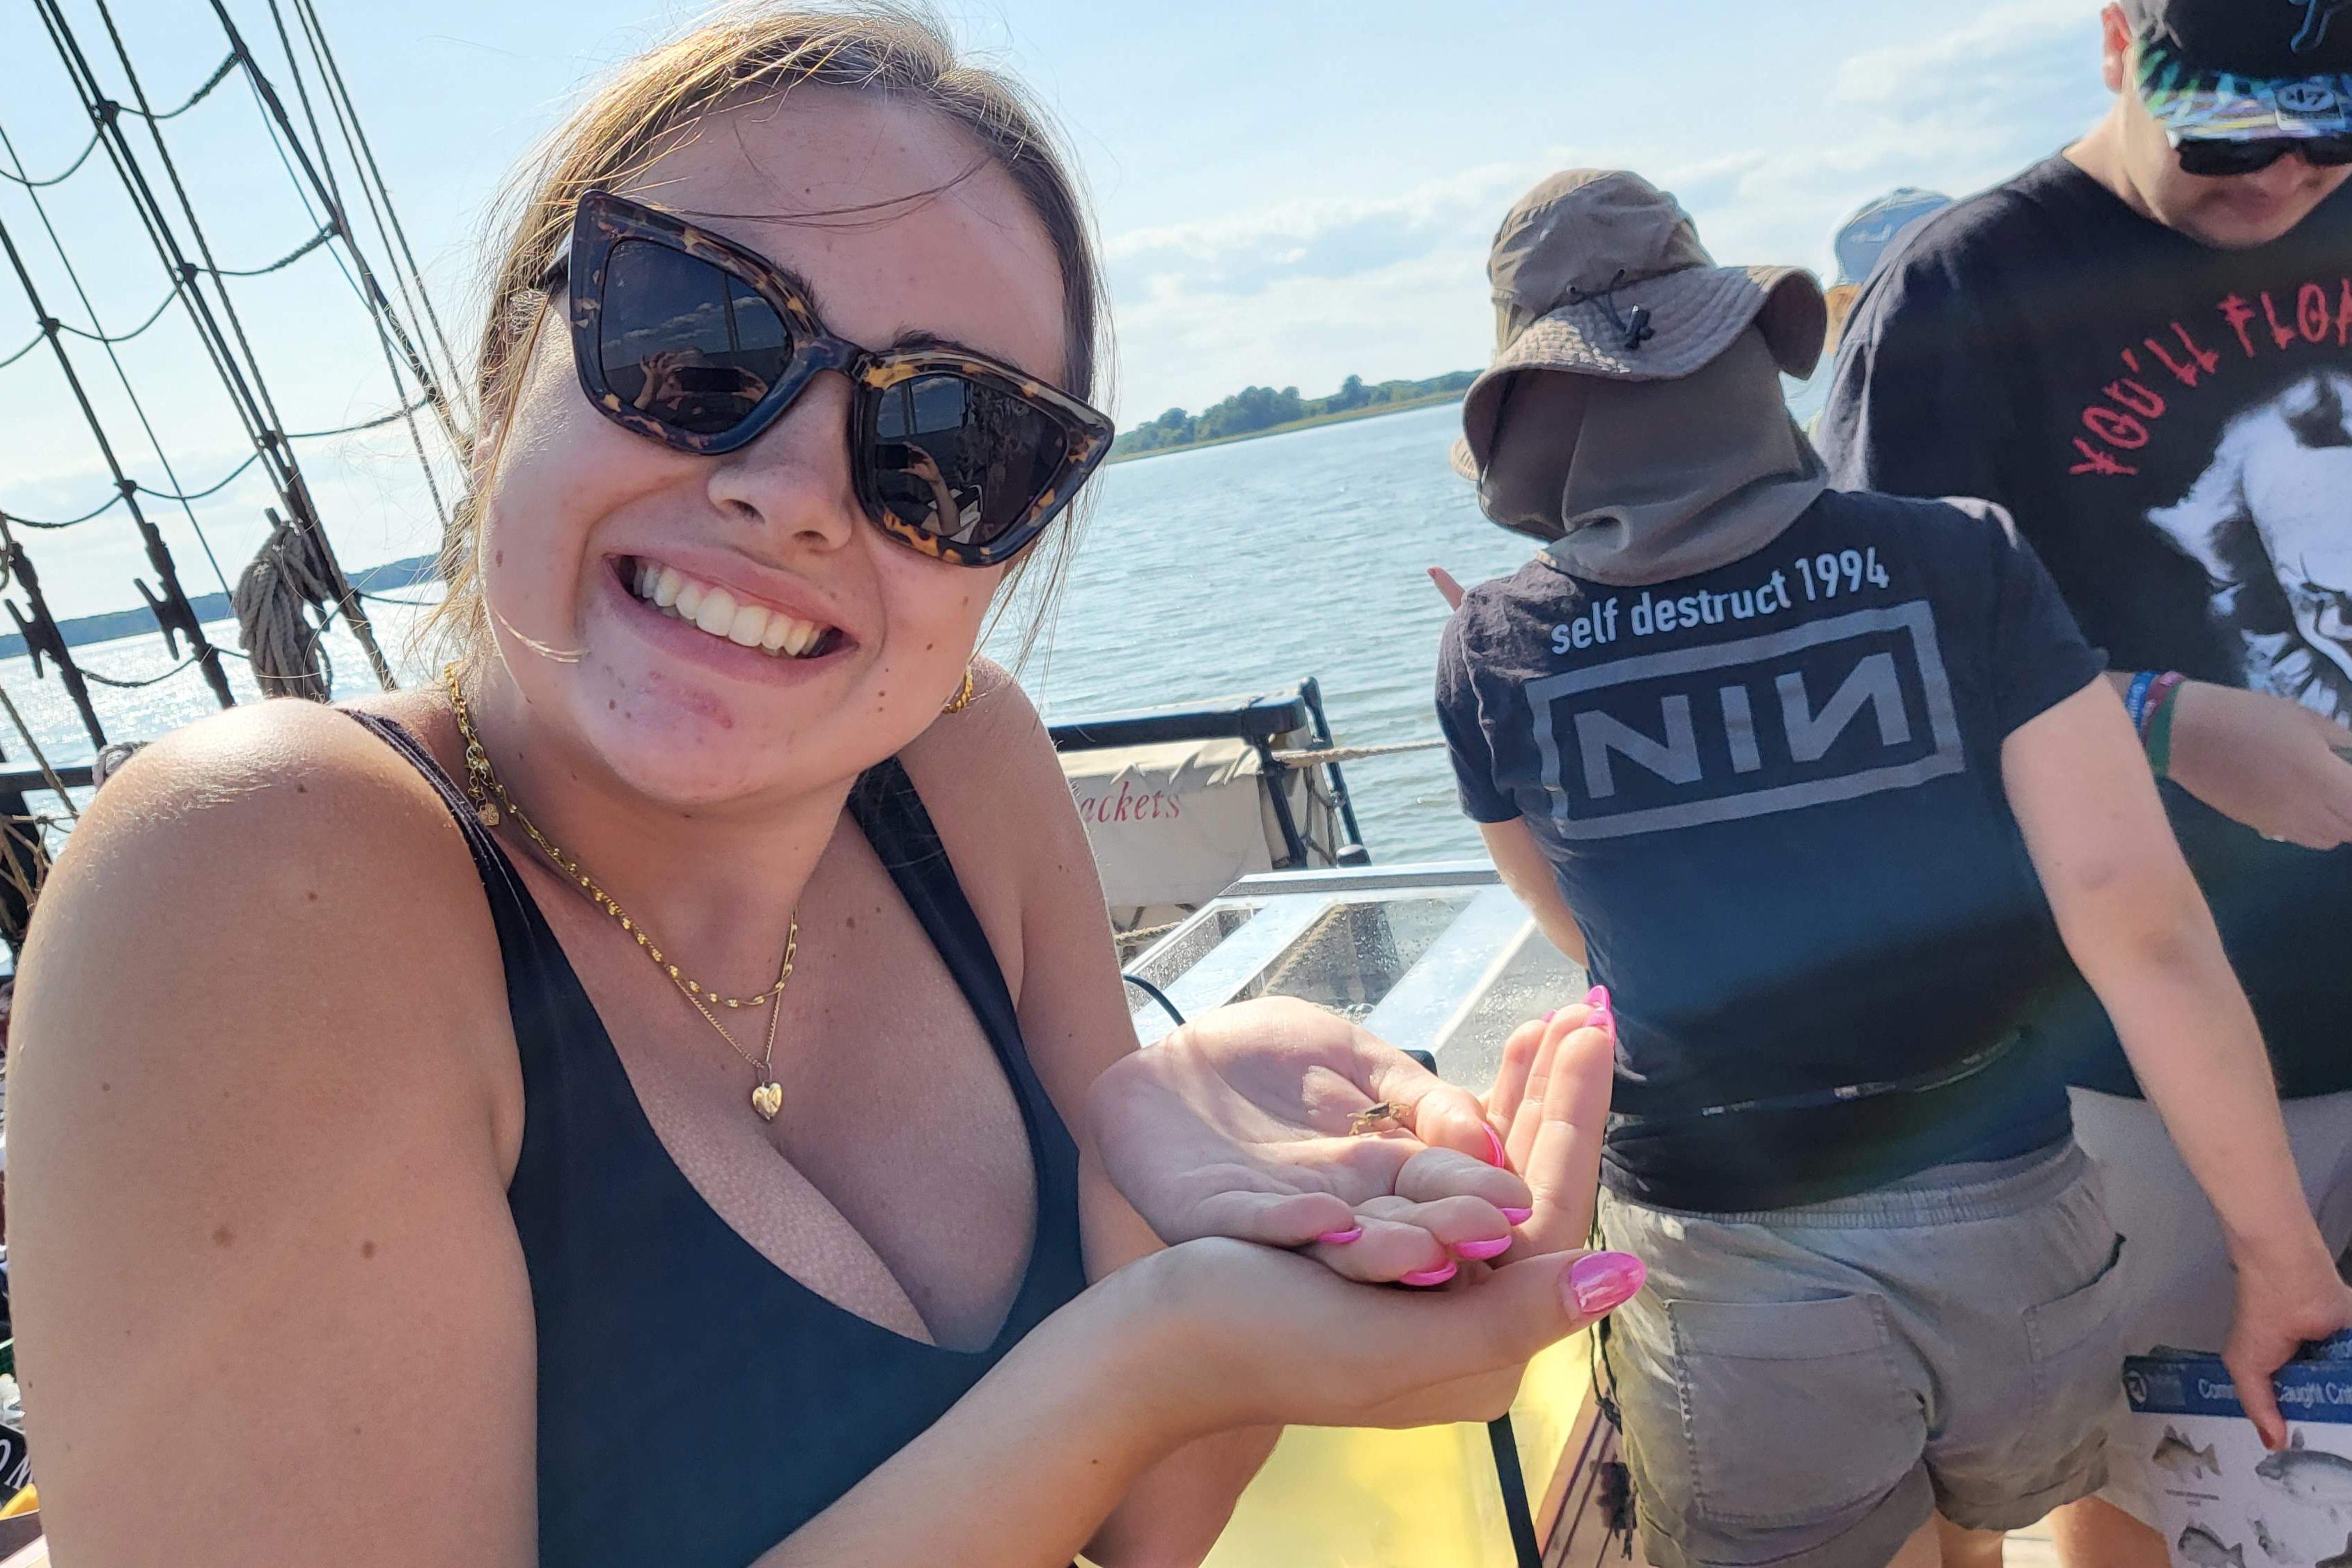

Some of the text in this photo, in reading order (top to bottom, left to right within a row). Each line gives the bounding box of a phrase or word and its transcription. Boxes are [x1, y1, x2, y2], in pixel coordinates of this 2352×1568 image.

[2069, 322, 2219, 475] YOU'LL
[1551, 547, 1889, 655] self destruct 1994
[1575, 653, 1911, 799] NIN
